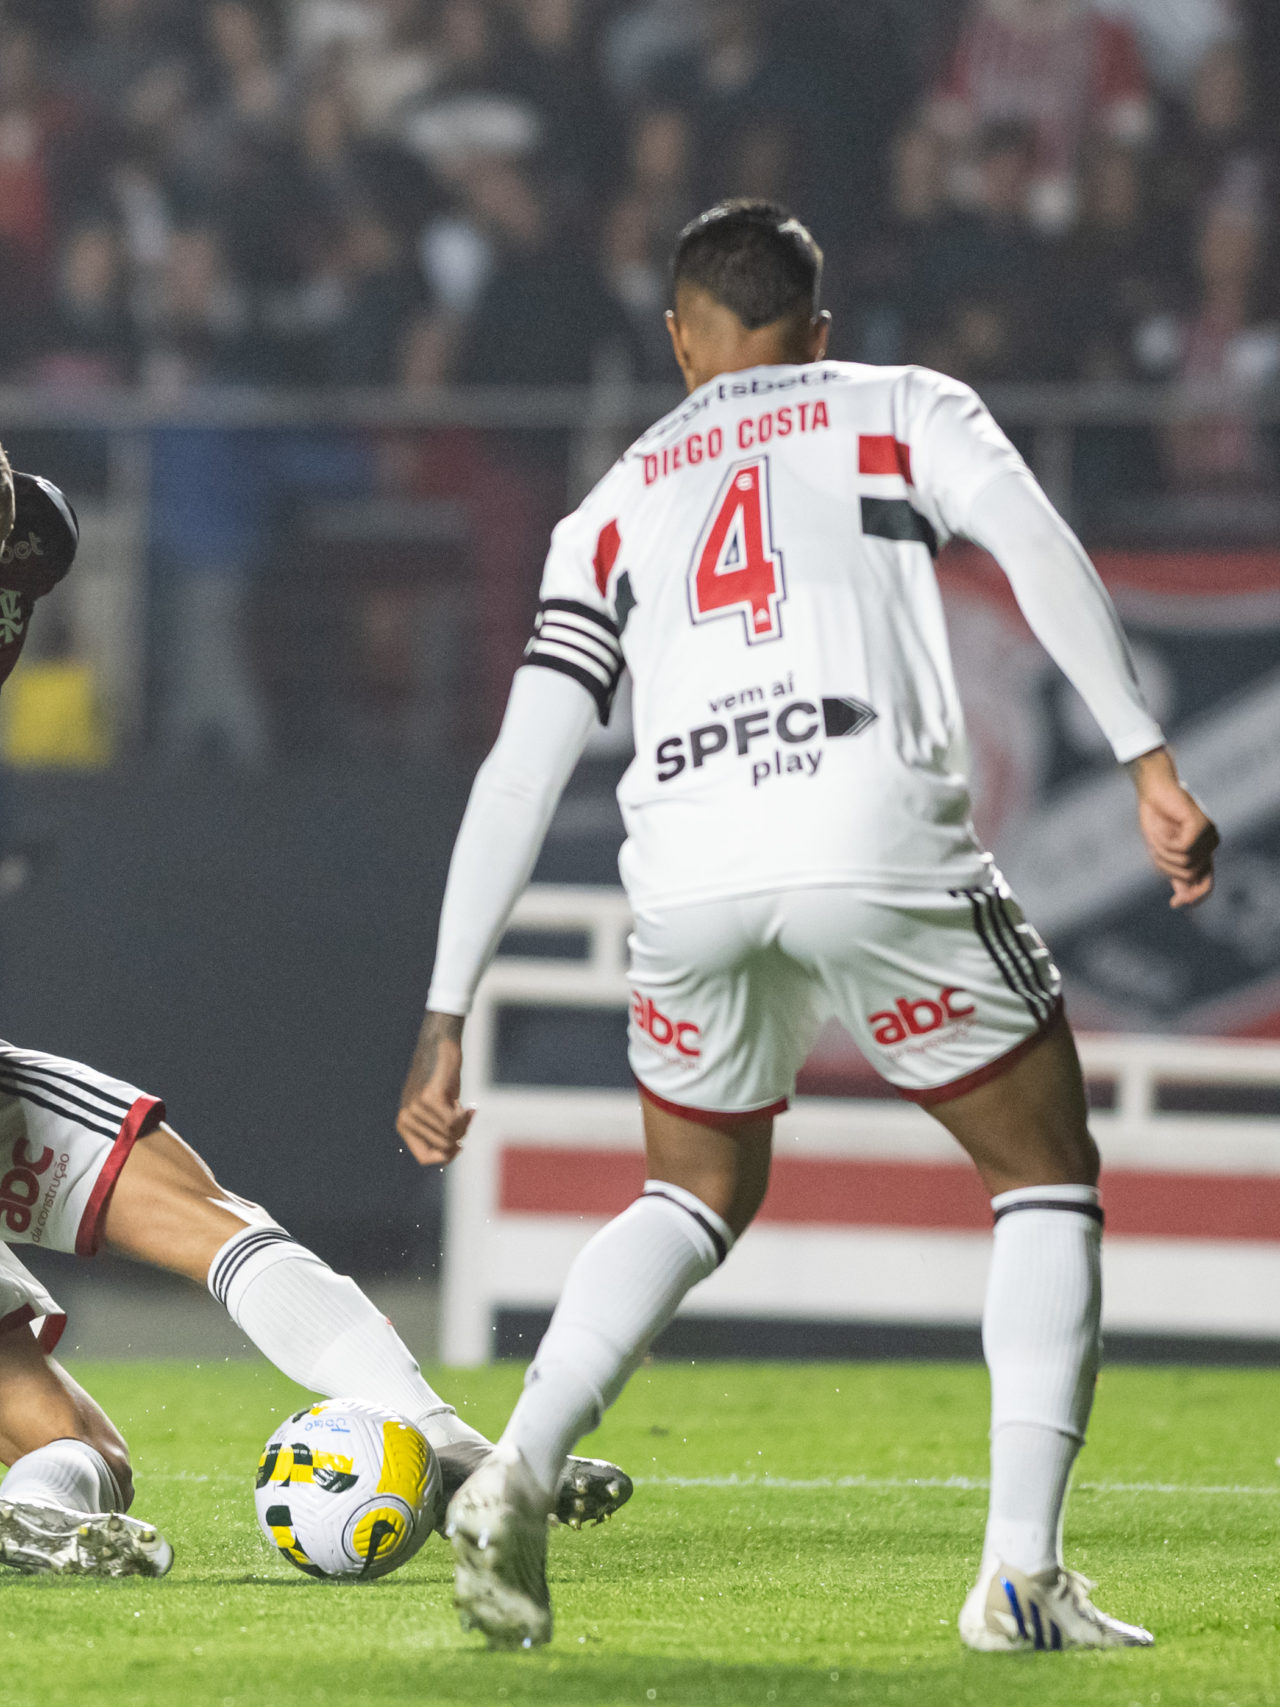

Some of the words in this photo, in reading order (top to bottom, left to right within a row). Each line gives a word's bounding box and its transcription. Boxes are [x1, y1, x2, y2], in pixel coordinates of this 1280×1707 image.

[643, 427, 723, 486] DIEGO
[738, 400, 830, 450] COSTA
[688, 454, 787, 645] 4
[708, 684, 764, 714] vem
[656, 701, 819, 783] SPFC
[752, 747, 823, 788] play
[867, 986, 976, 1046] abc
[38, 1152, 70, 1230] construção
